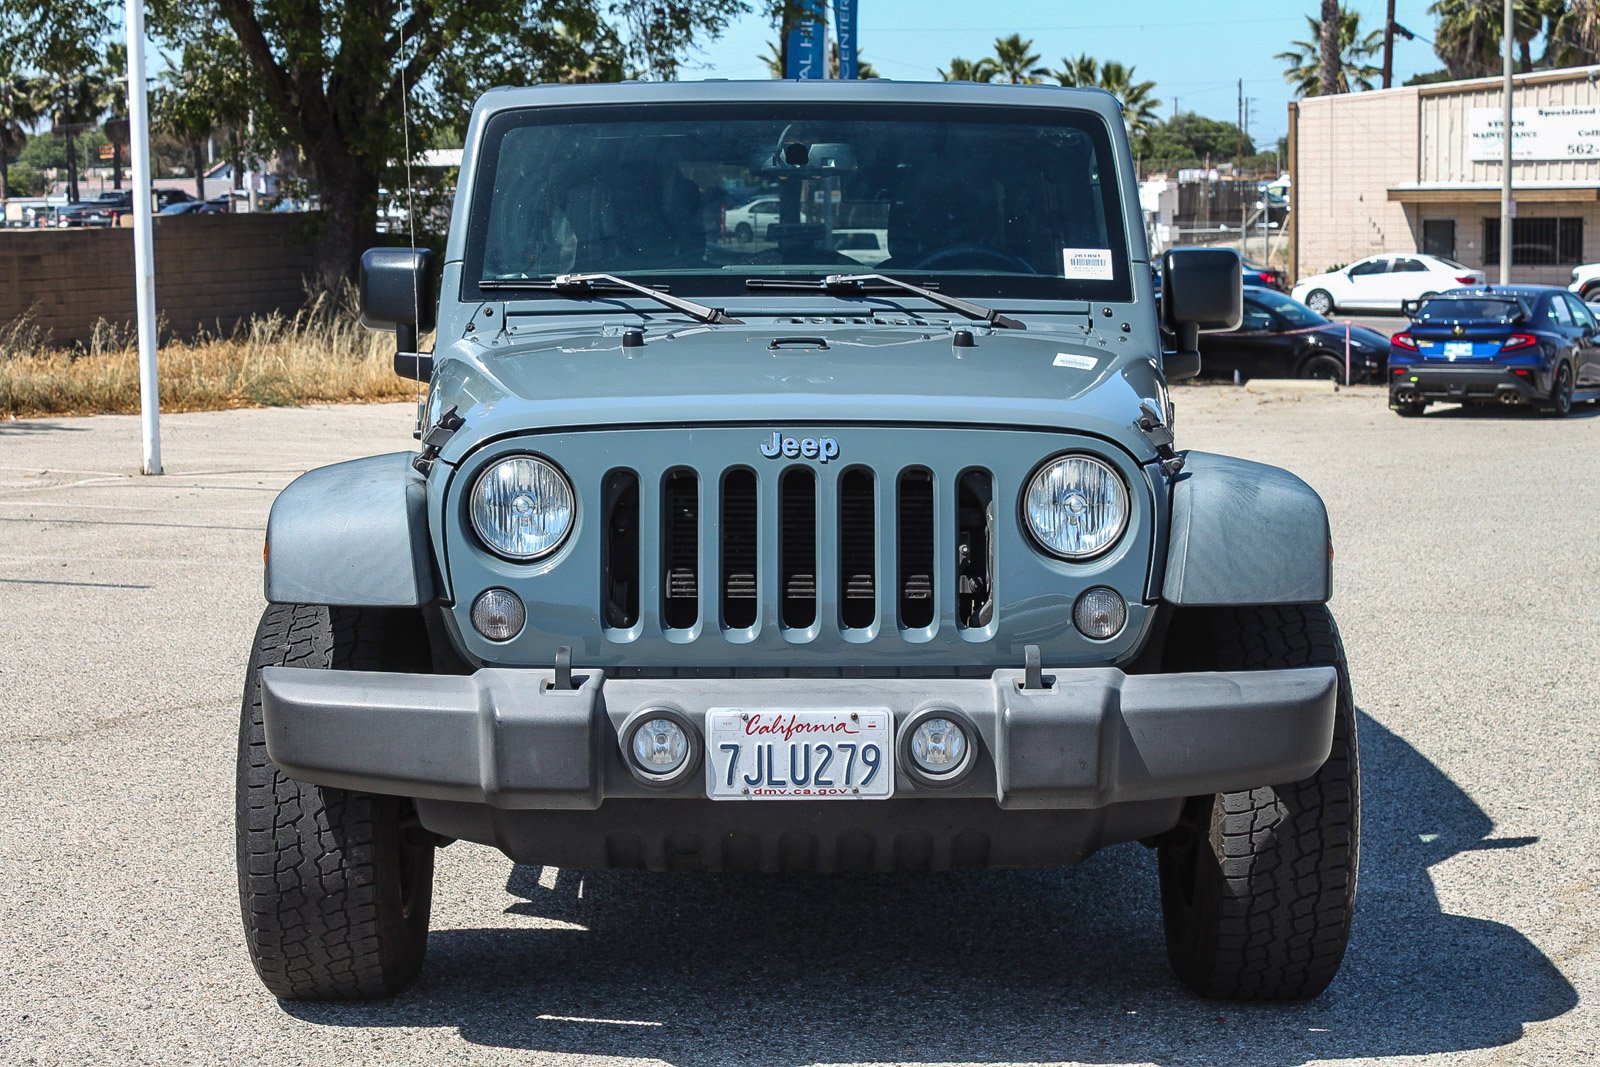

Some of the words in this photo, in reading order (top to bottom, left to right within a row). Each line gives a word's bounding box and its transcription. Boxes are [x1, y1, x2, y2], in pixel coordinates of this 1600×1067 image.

[760, 432, 839, 463] Jeep
[745, 714, 859, 741] California
[720, 744, 881, 785] 7JLU279
